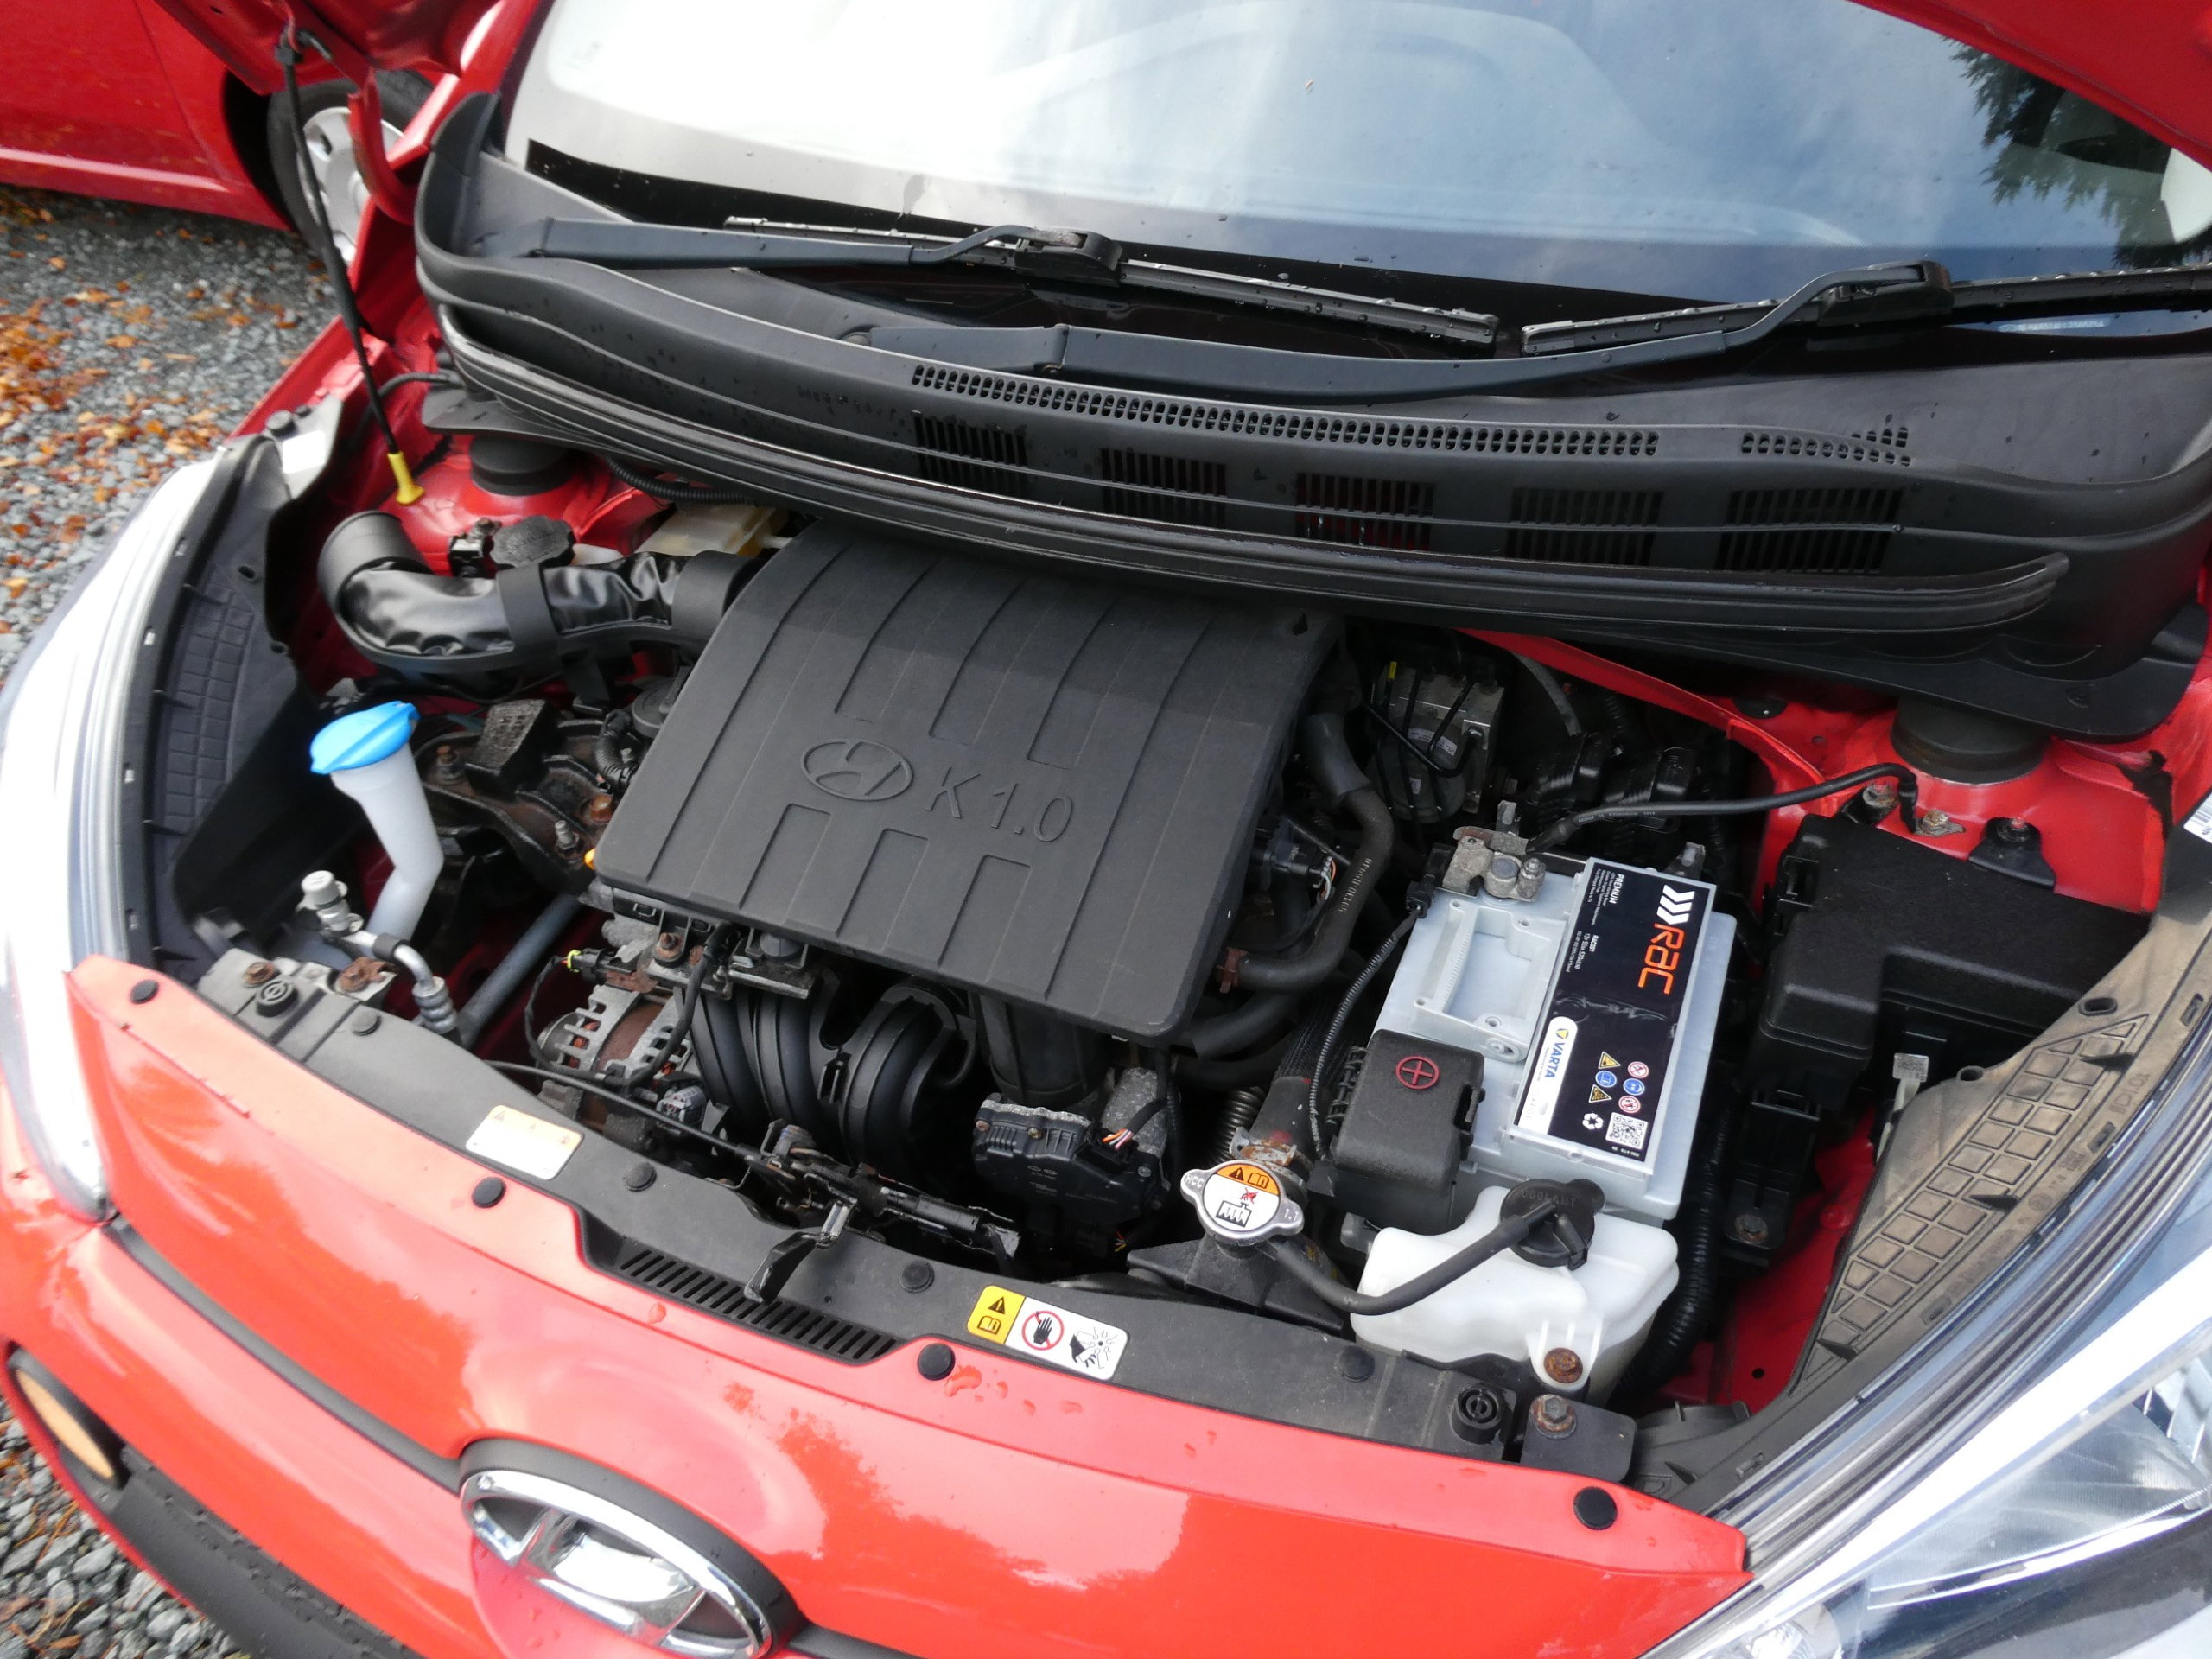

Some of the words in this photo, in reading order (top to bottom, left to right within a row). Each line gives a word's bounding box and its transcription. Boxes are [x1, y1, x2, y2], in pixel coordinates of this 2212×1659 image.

[925, 766, 981, 819] K
[991, 783, 1073, 843] 1.0
[1609, 874, 1624, 904] PREMIUM
[1545, 1042, 1565, 1077] VARTA
[1184, 1174, 1205, 1188] HCC
[1522, 1189, 1575, 1208] COOLANT
